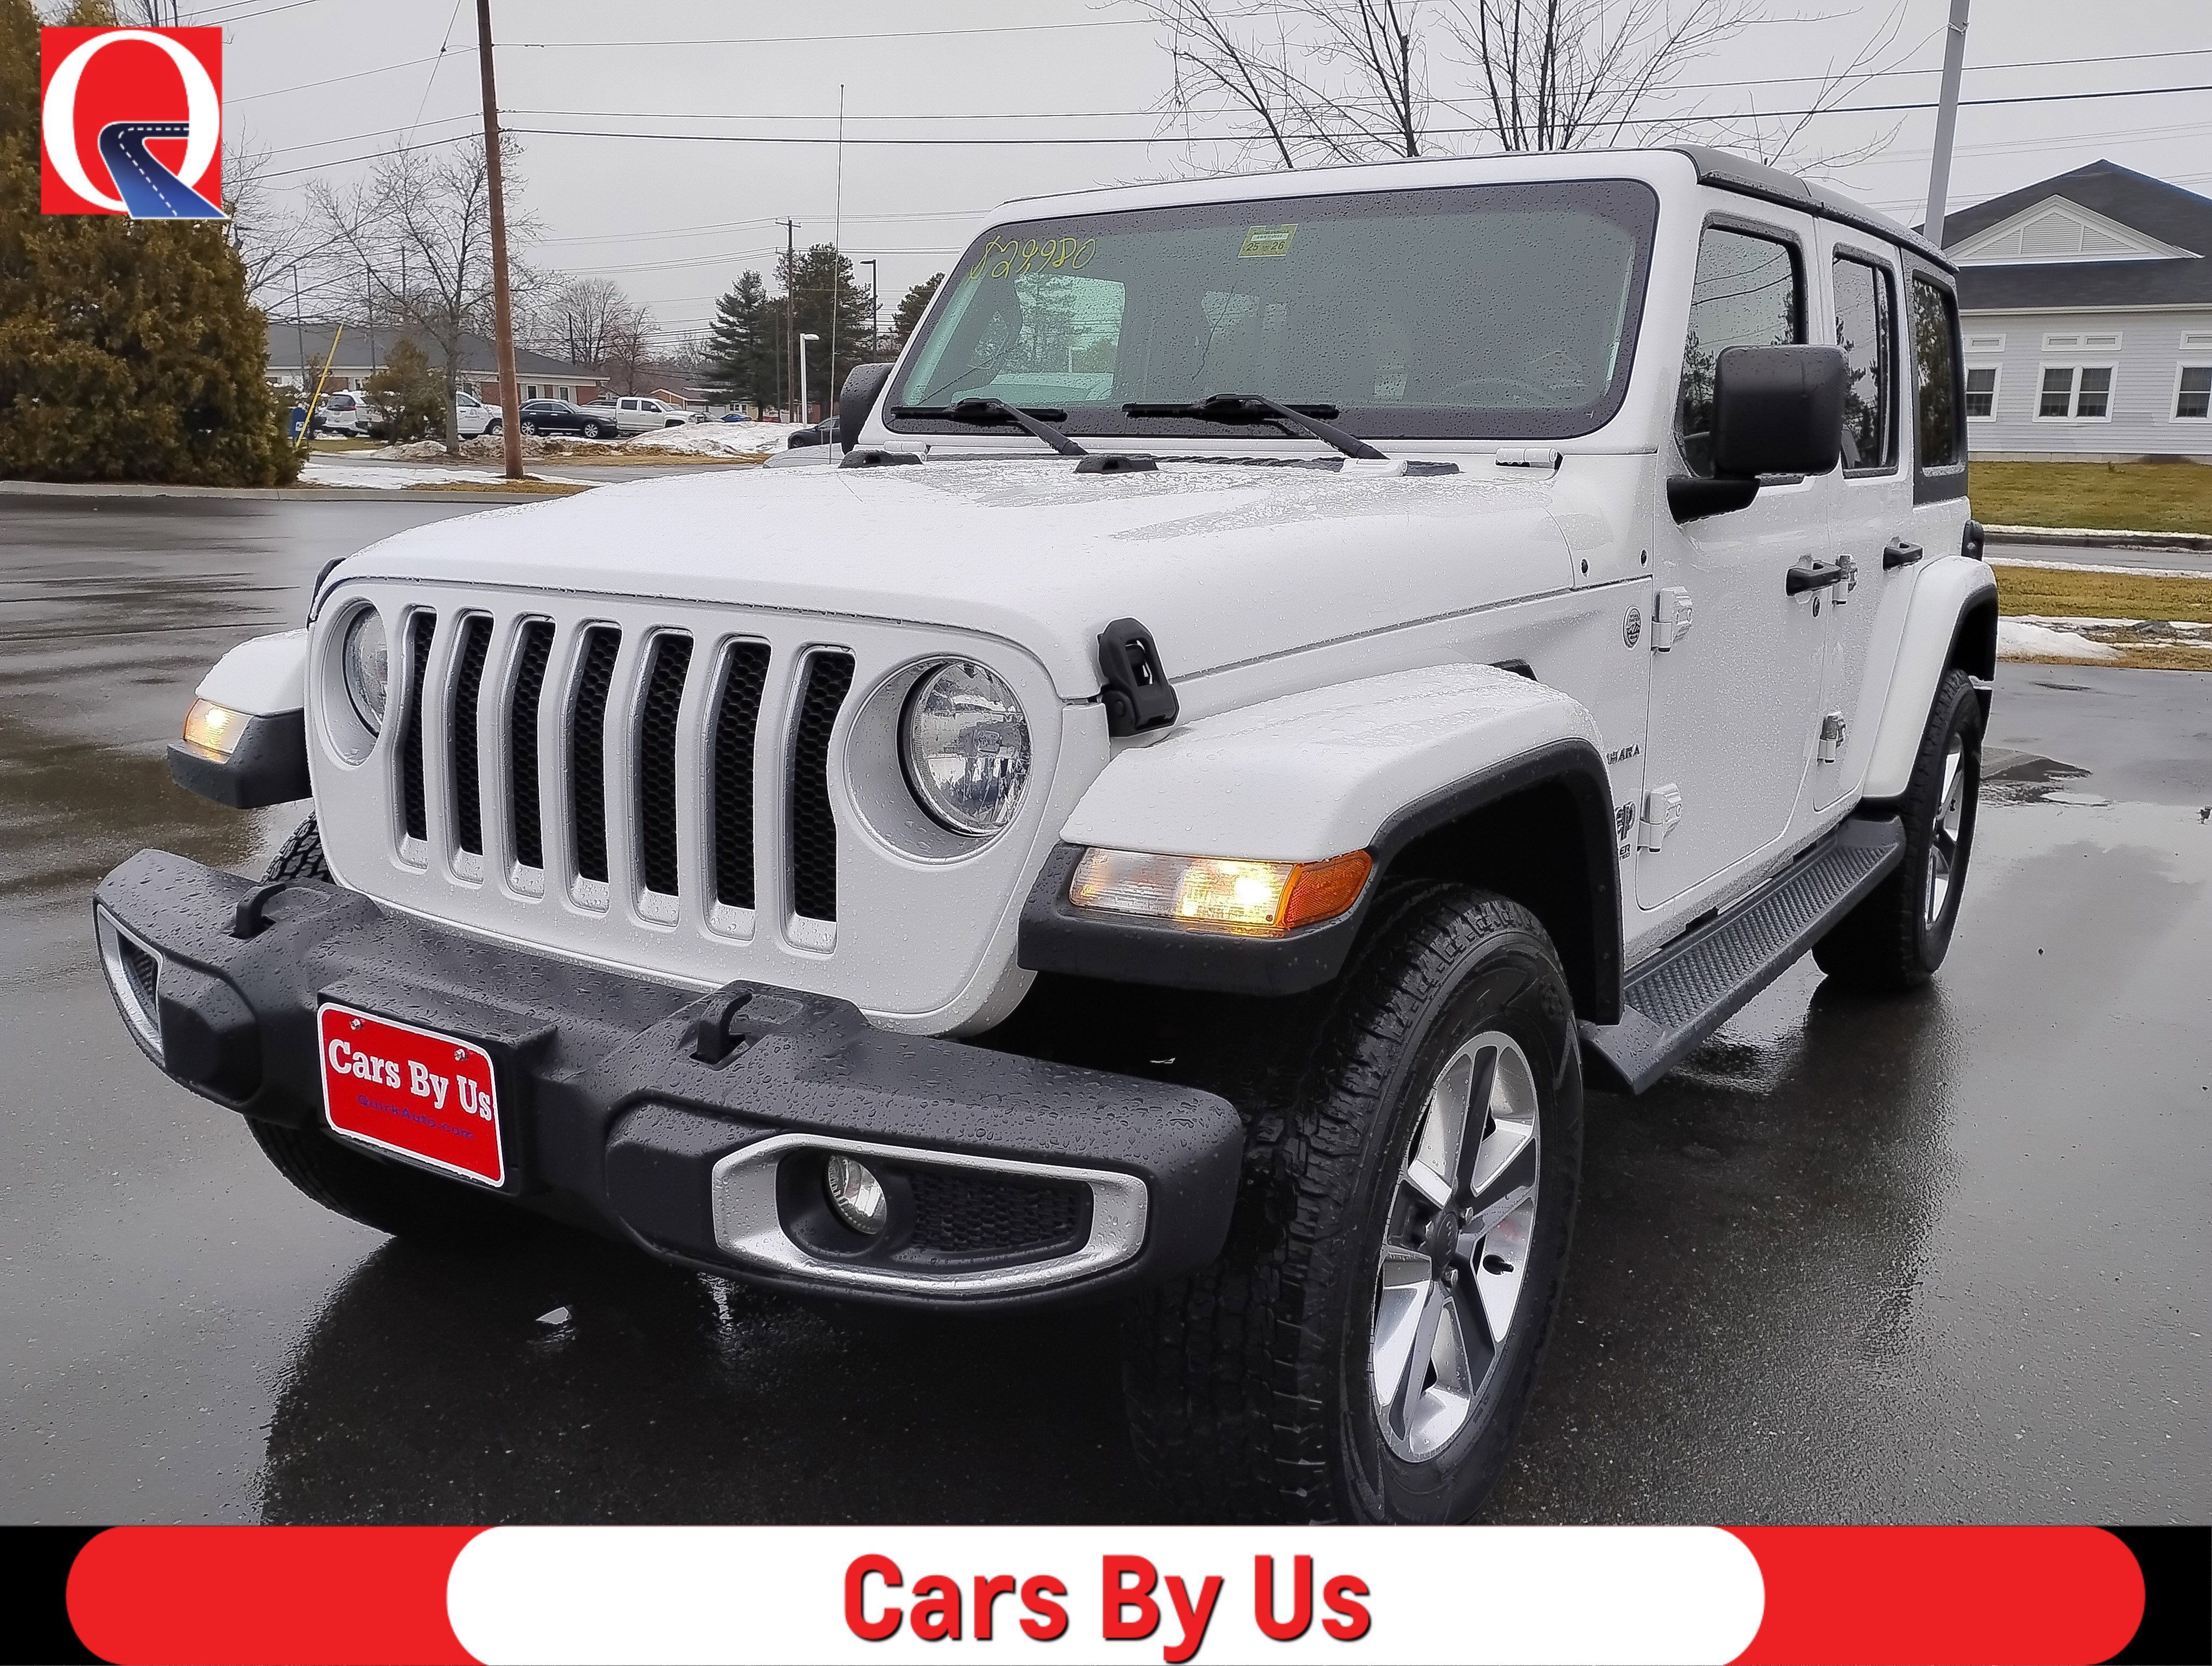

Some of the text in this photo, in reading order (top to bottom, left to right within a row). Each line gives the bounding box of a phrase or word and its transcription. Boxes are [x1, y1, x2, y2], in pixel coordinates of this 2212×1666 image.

[1246, 241, 1285, 251] 25 26
[1606, 744, 1640, 765] HARA
[329, 1039, 492, 1122] Cars By Us
[357, 1094, 474, 1140] QuirkAuto.com
